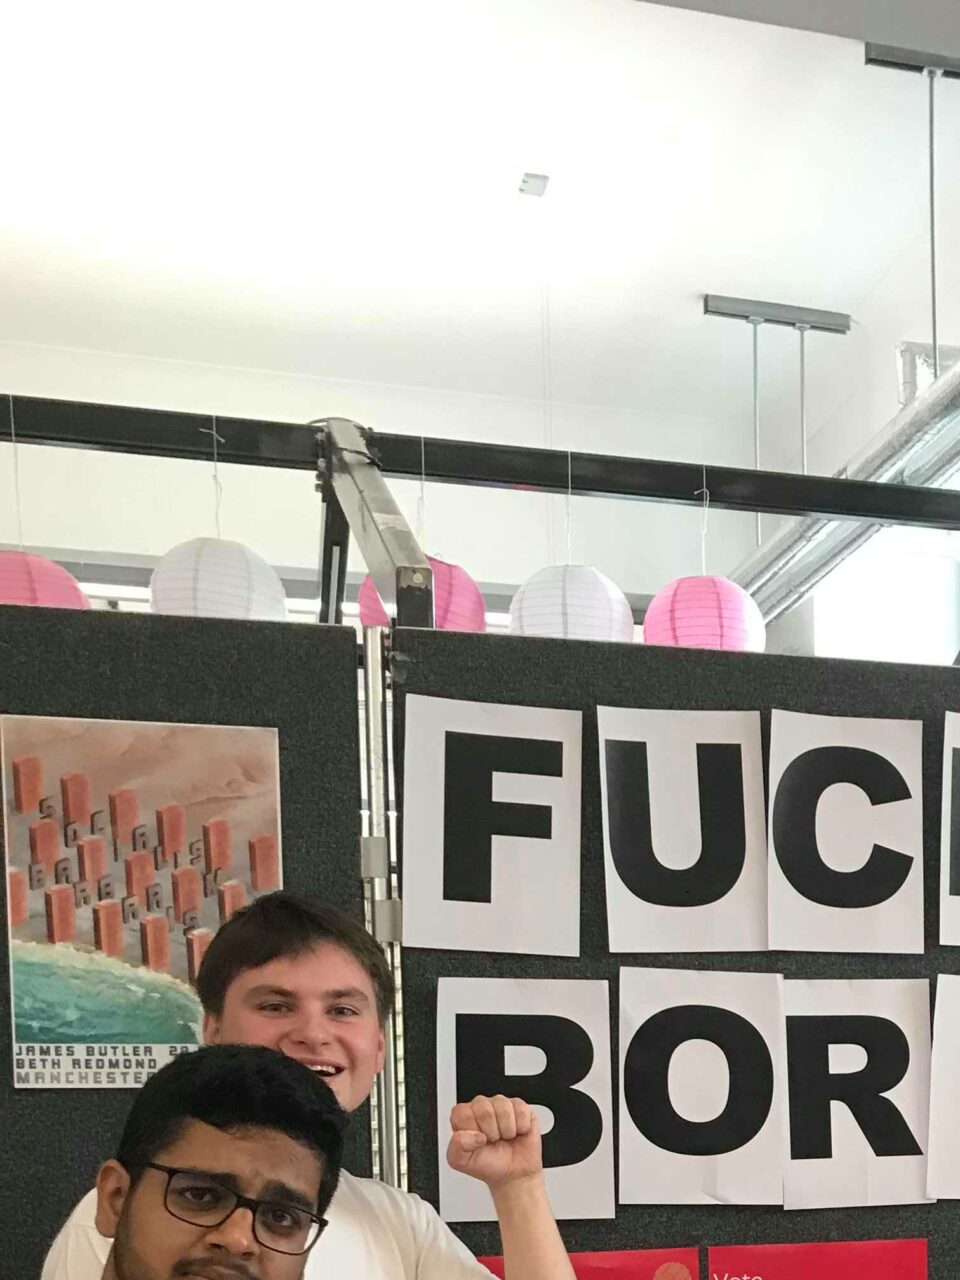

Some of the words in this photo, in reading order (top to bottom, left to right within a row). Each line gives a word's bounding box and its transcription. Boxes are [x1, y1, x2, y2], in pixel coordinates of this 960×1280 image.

[16, 1045, 76, 1057] JAMES
[86, 1045, 154, 1057] BUTLER
[16, 1058, 61, 1070] BETH
[72, 1058, 158, 1070] REDMOND
